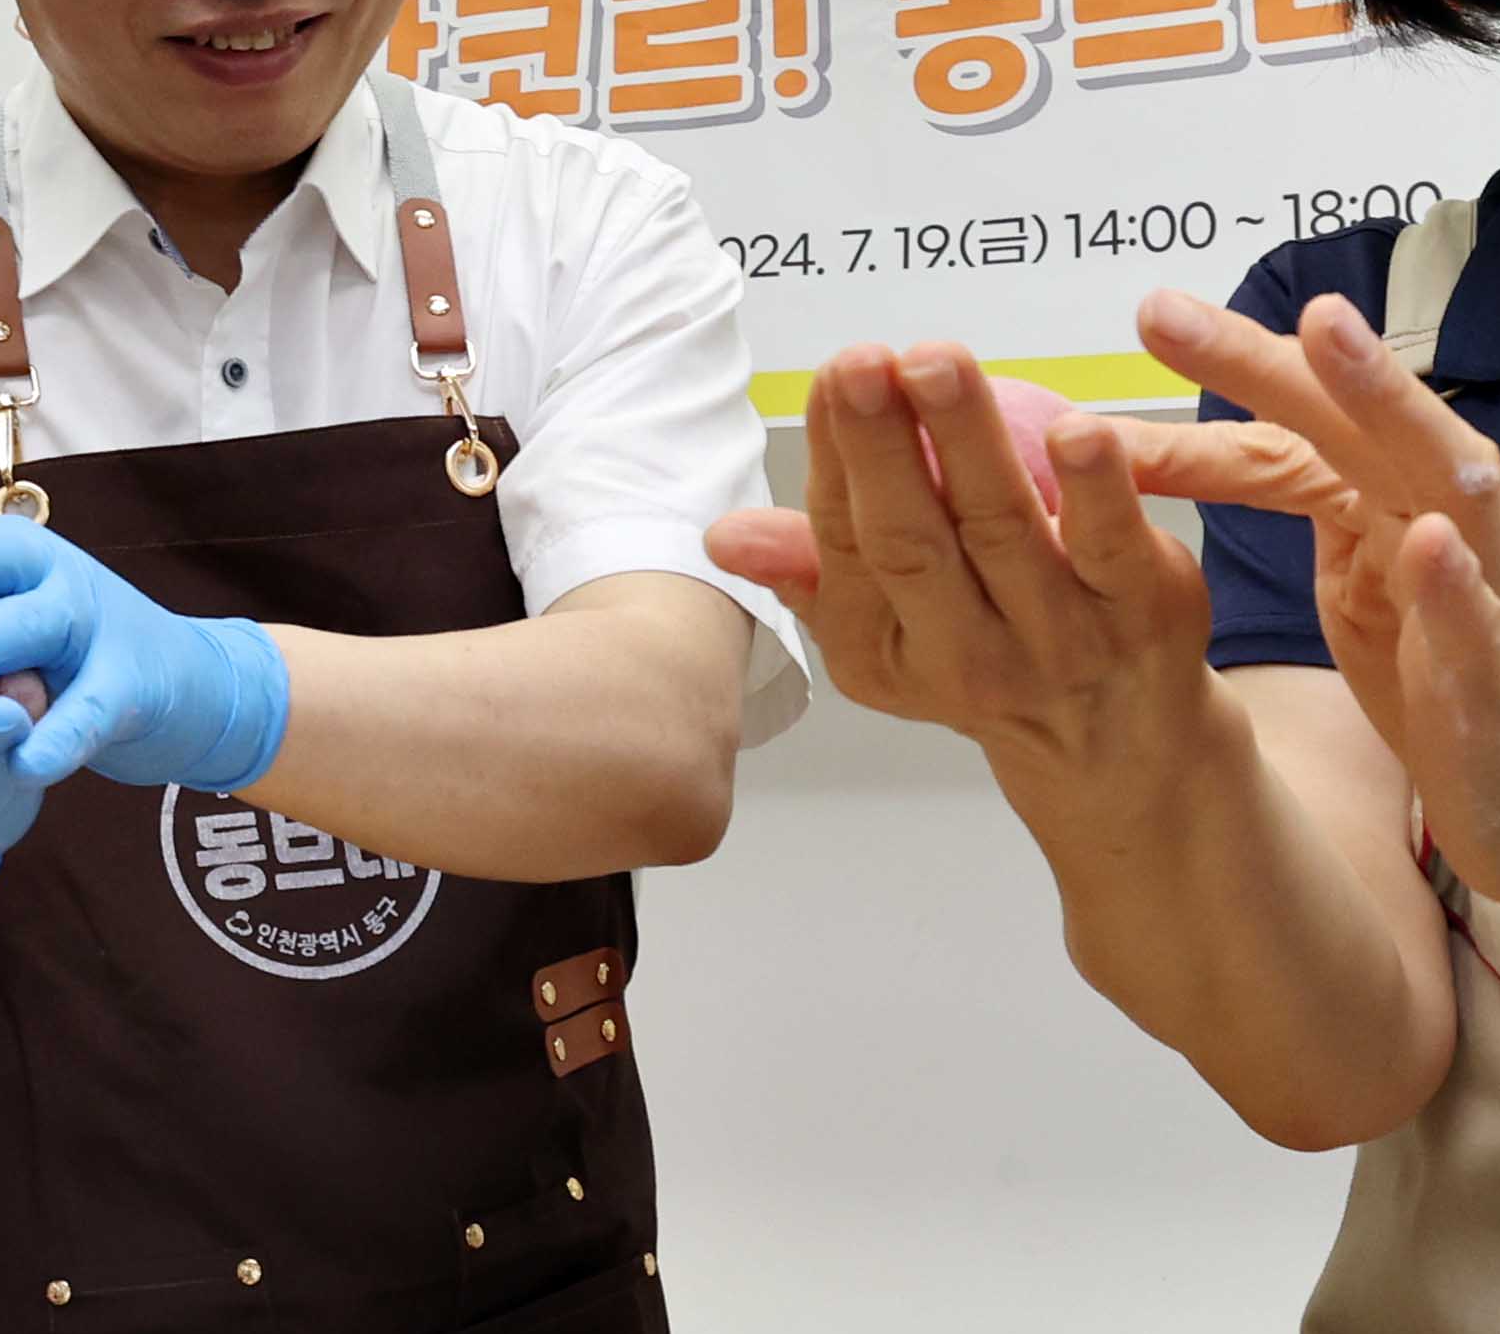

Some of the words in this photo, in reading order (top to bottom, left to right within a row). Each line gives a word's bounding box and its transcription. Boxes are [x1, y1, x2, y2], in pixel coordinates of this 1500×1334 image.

[841, 229, 877, 273] 7.
[893, 213, 1049, 269] 19.(금)
[1064, 201, 1217, 259] 14:00
[257, 923, 363, 958] 인천광역시
[362, 895, 399, 935] 동구
